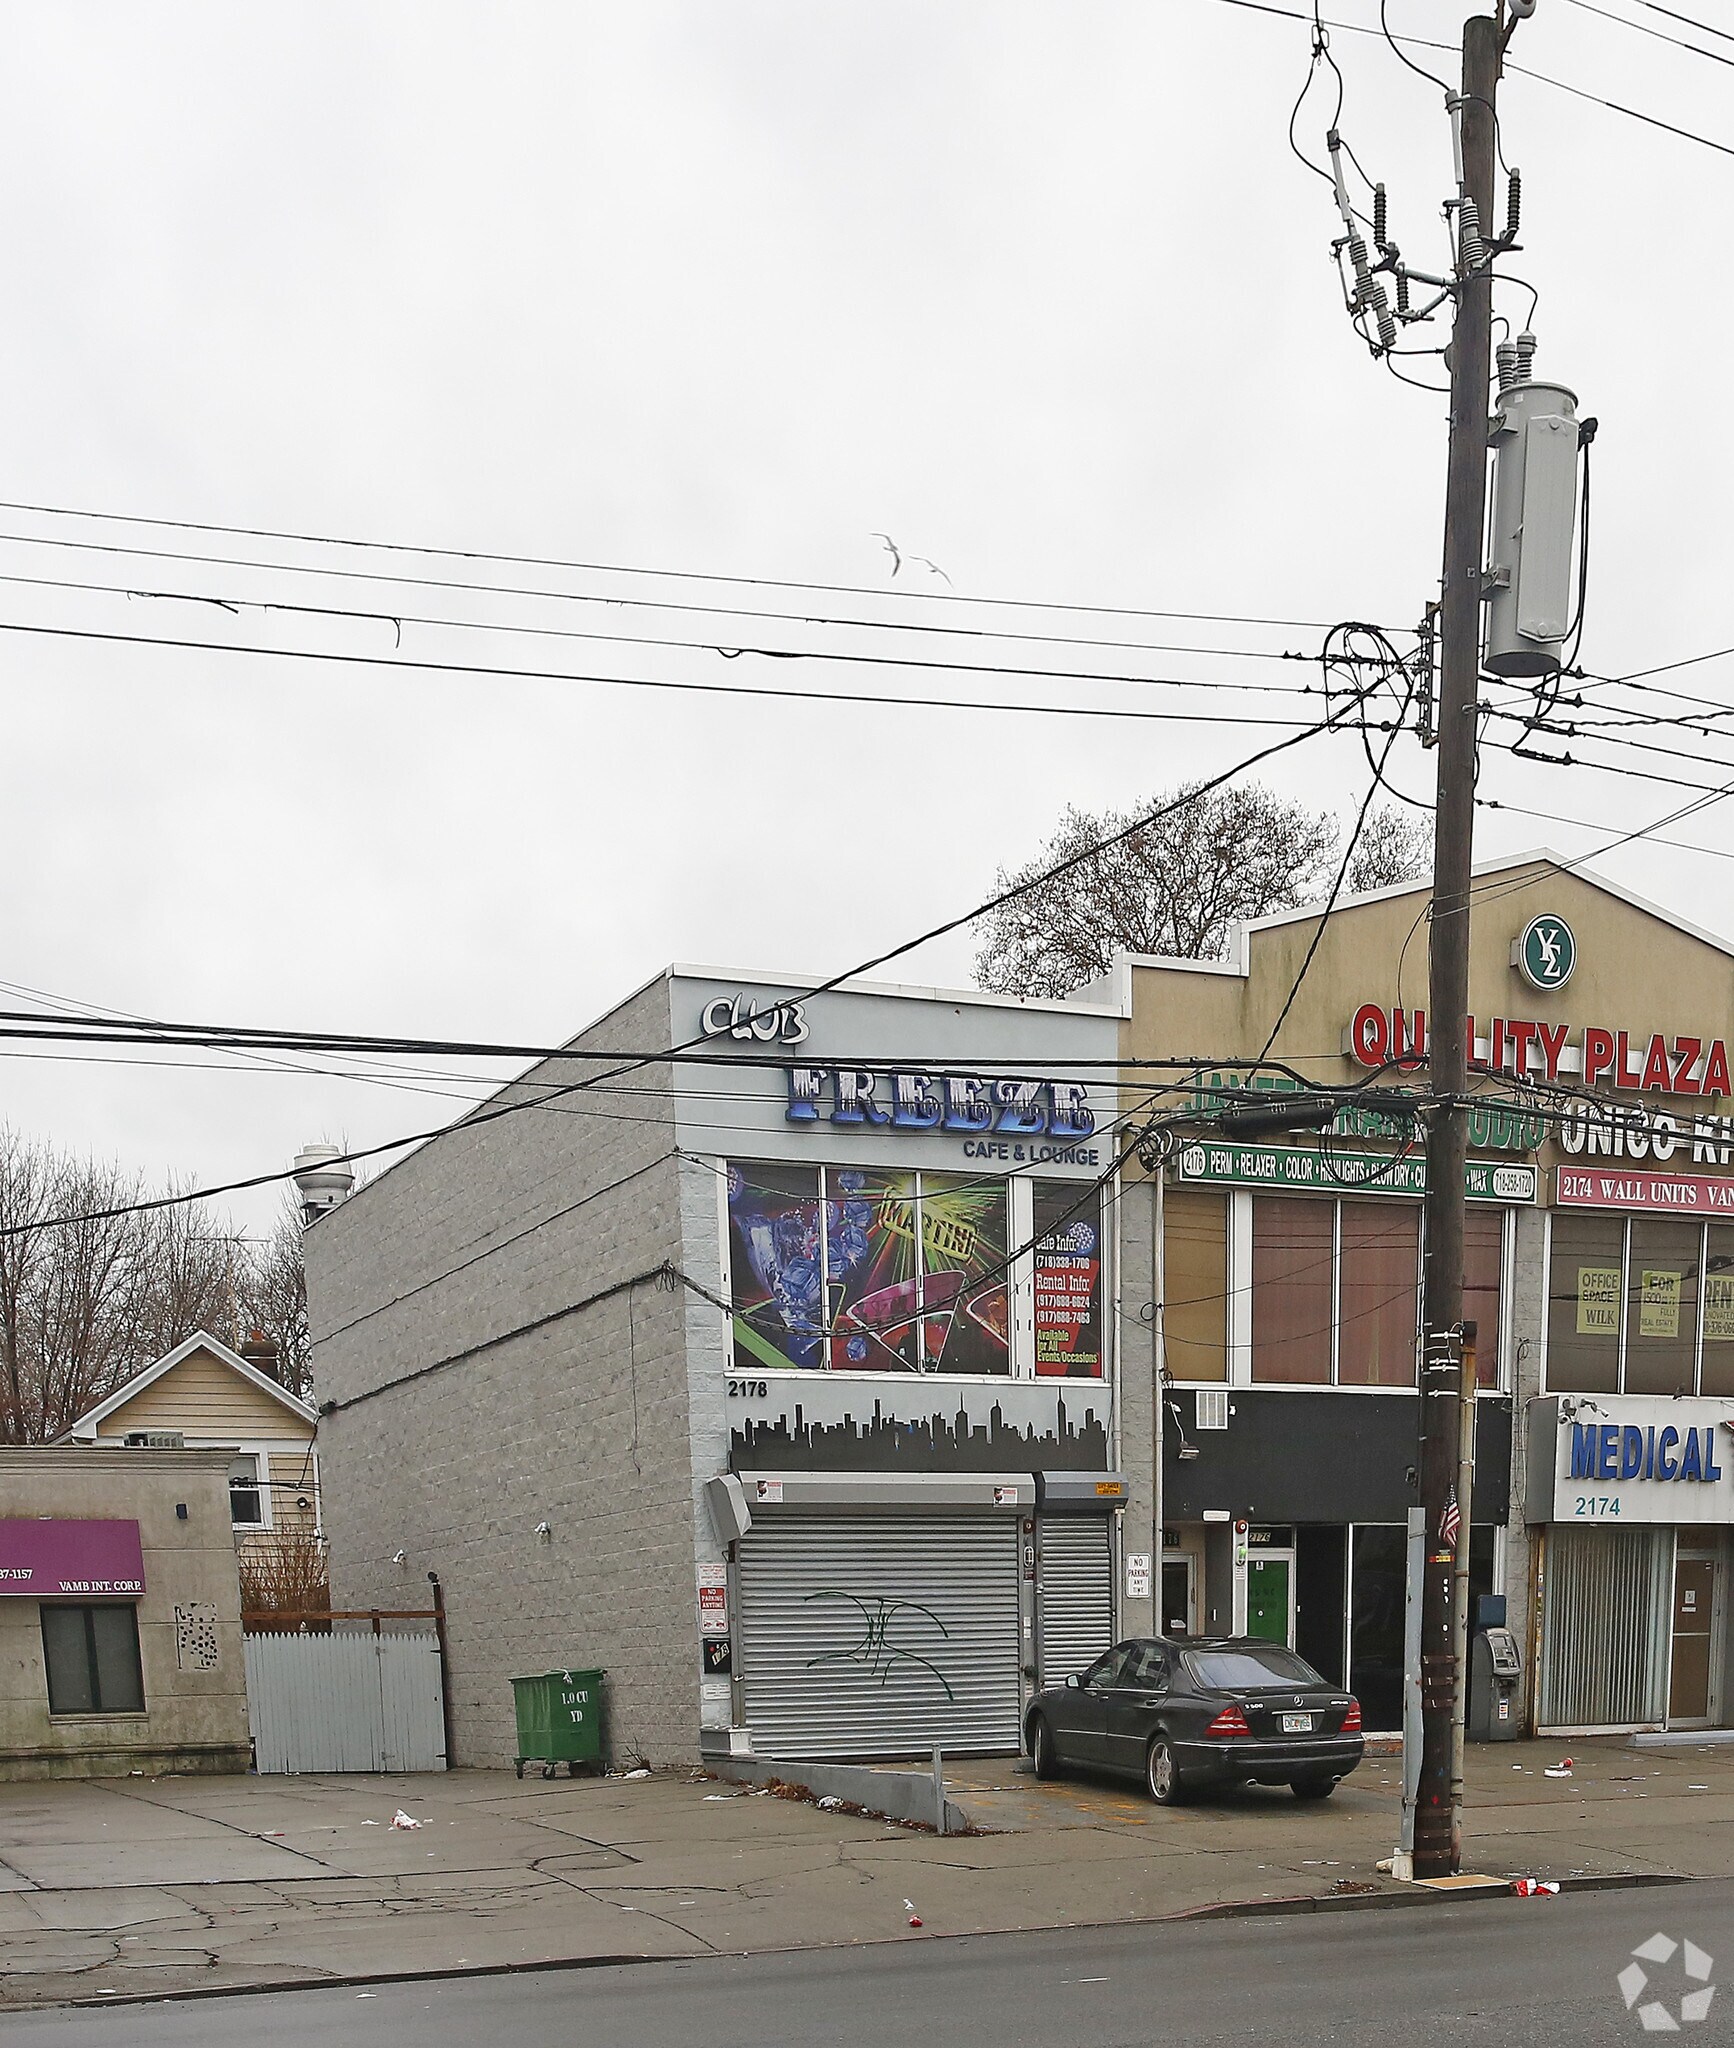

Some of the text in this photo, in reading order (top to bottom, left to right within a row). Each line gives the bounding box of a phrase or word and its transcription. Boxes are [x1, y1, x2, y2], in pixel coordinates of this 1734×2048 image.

[701, 991, 810, 1044] CLUB
[1351, 1004, 1732, 1097] QULITY PLAZA
[785, 1065, 1096, 1141] FREEZE
[1561, 1103, 1677, 1161] UNICO
[963, 1140, 1099, 1166] CAFE & LOUNGE
[1210, 1150, 1233, 1175] PERM
[1240, 1152, 1277, 1178] RELAXER
[1286, 1156, 1313, 1180] COLOR
[1470, 1169, 1488, 1192] WAX
[1563, 1176, 1593, 1198] 2174
[1600, 1178, 1646, 1201] WALL
[1650, 1181, 1697, 1205] UNITS
[1036, 1273, 1066, 1291] Rental
[1582, 1273, 1618, 1289] OFFICE
[1582, 1290, 1614, 1303] SPACE
[1586, 1309, 1616, 1325] WILK
[728, 1380, 767, 1398] 2178
[1568, 1423, 1722, 1482] MEDICAL
[1575, 1497, 1621, 1516] 2174
[1133, 1558, 1144, 1567] NO
[59, 1581, 142, 1592] VAMB INT. CORP.
[561, 1690, 589, 1705] 1.0 CU
[570, 1710, 583, 1722] YD
